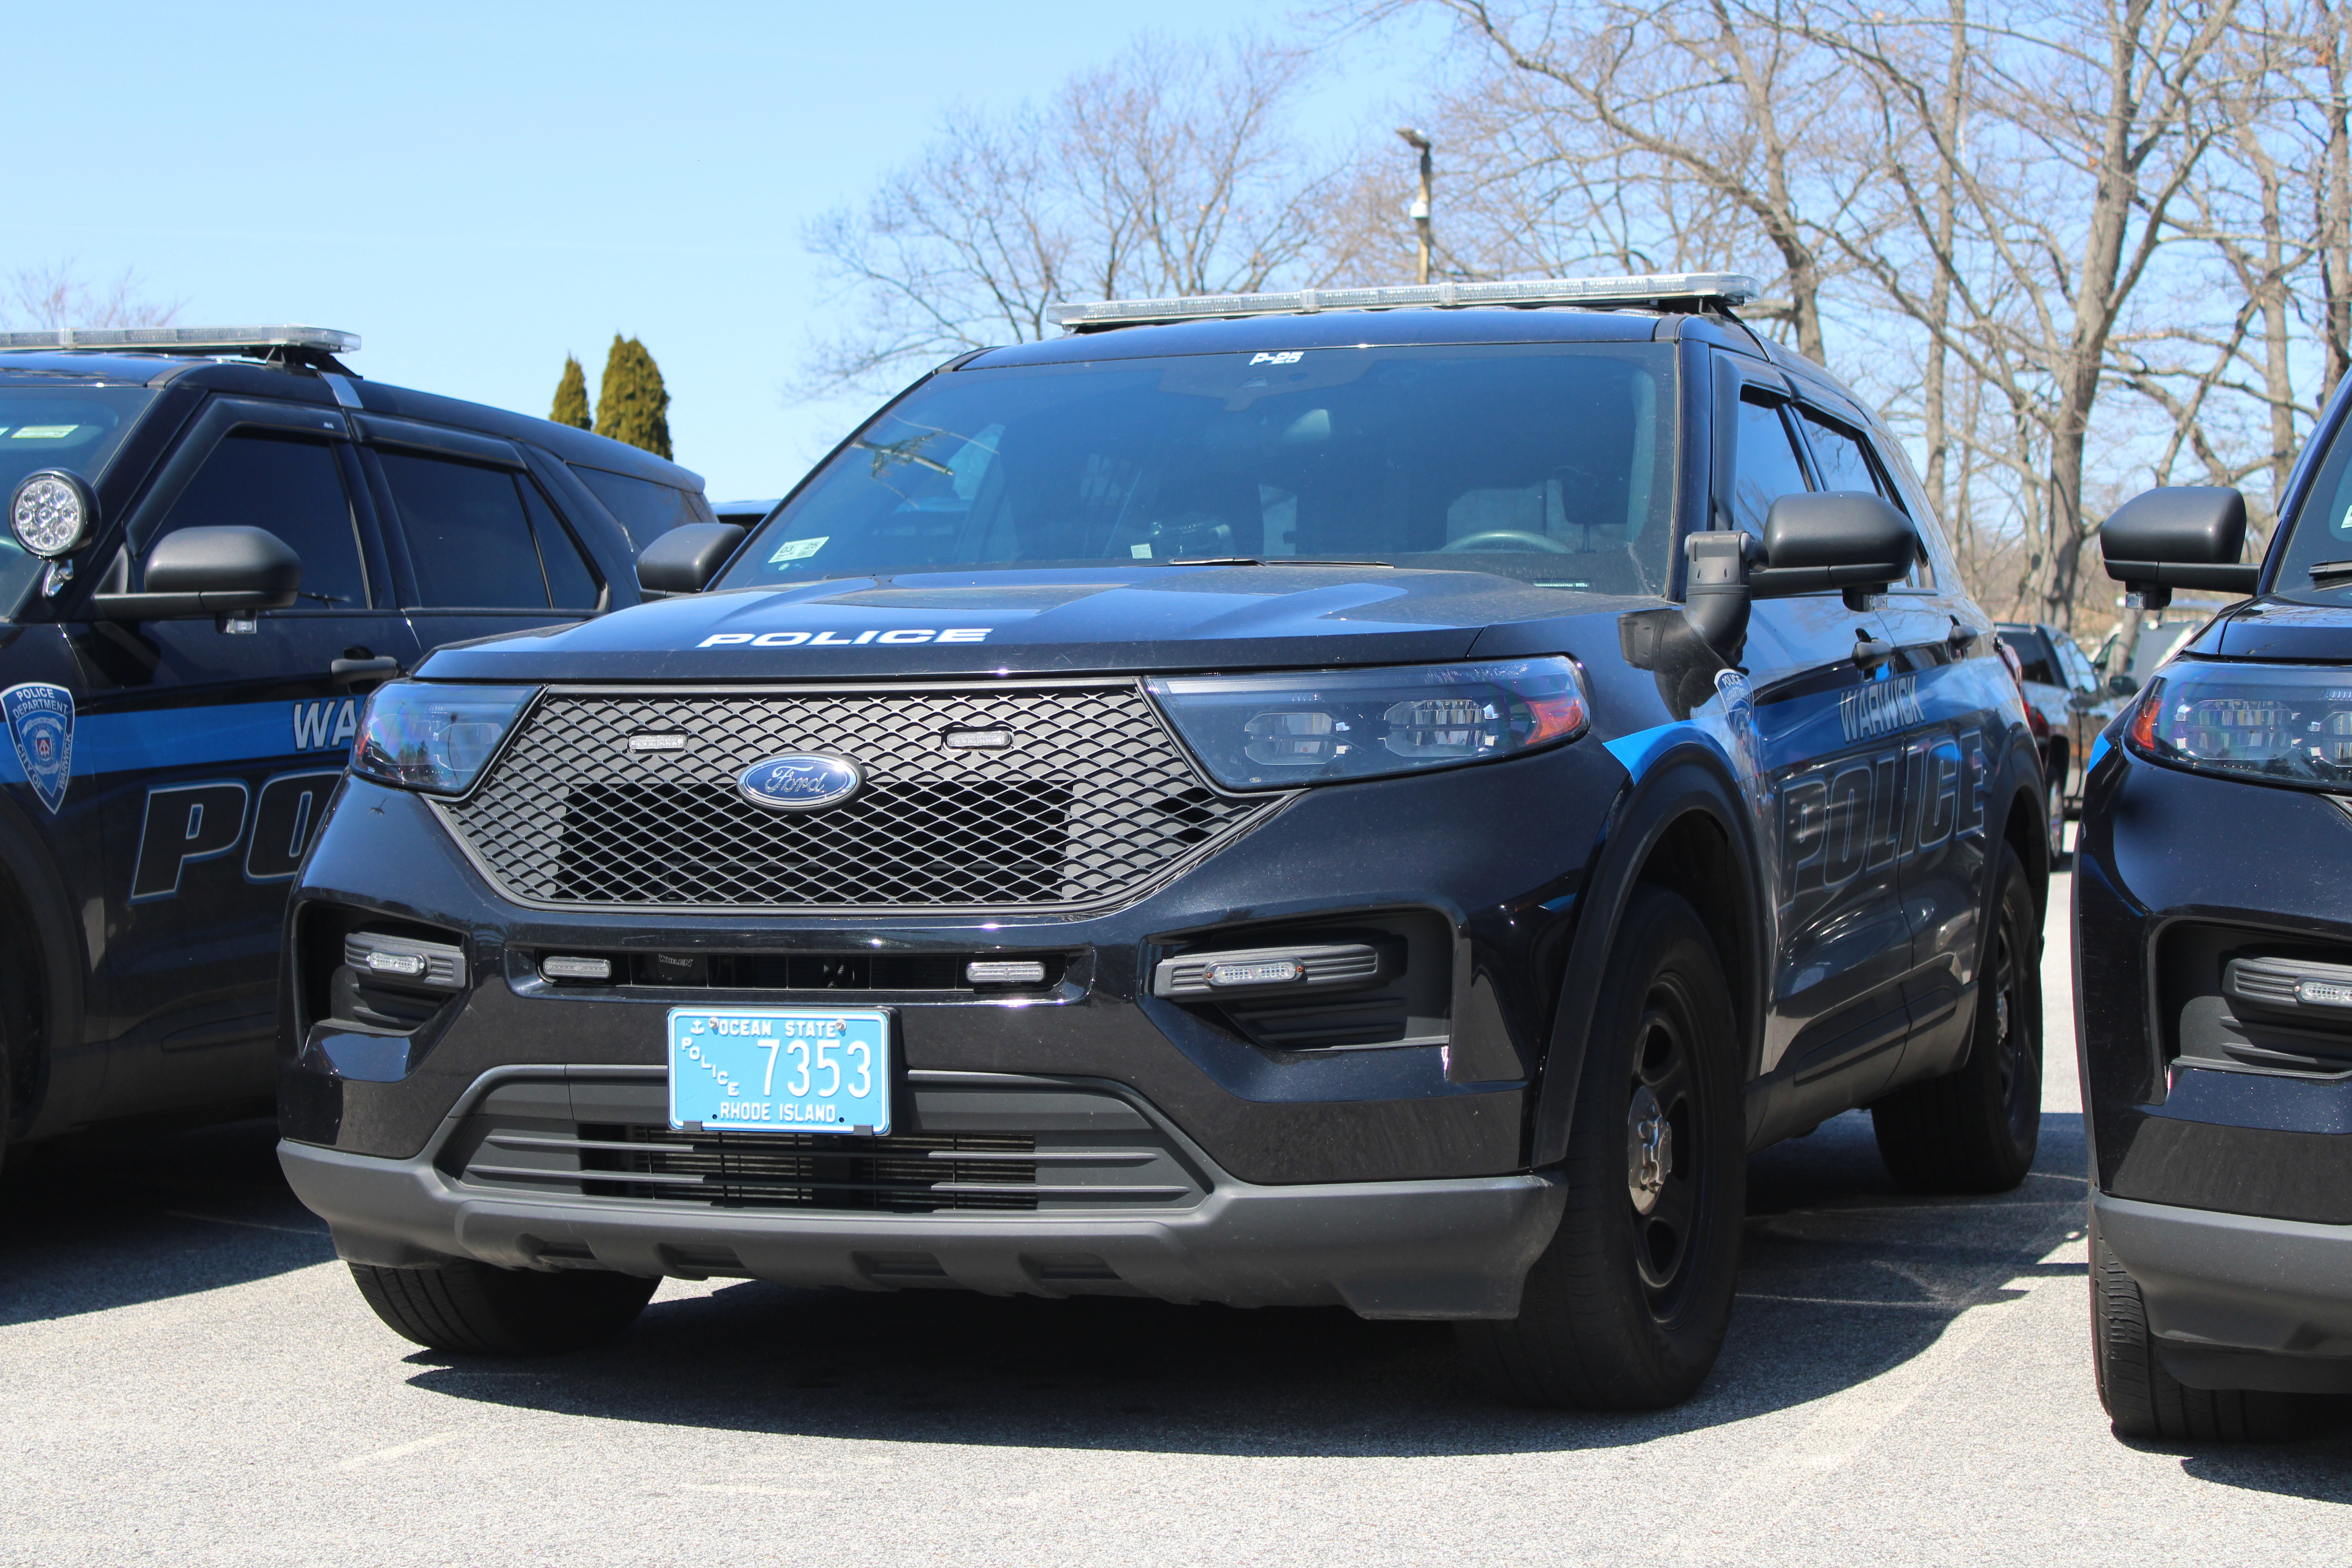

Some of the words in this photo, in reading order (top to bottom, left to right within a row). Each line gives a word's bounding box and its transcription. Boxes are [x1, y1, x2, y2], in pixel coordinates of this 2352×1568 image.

[1248, 351, 1305, 366] P-25
[695, 628, 995, 648] POLICE
[1722, 674, 1743, 689] POLICE
[16, 688, 54, 701] POLICE
[13, 699, 68, 719] DEPARTMENT
[1839, 675, 1926, 743] WARWICK
[17, 743, 33, 773] CITY
[32, 775, 44, 791] OF
[58, 732, 72, 791] WARWICK
[764, 765, 828, 794] Ford
[1777, 728, 1985, 914] POLICE
[659, 954, 692, 967] WHELEN
[719, 1020, 771, 1036] OCEAN
[785, 1021, 836, 1038] STATE
[681, 1037, 739, 1097] POLICE
[757, 1039, 871, 1099] 7353
[720, 1102, 771, 1122] RHODE
[779, 1103, 836, 1123] ISLAND
